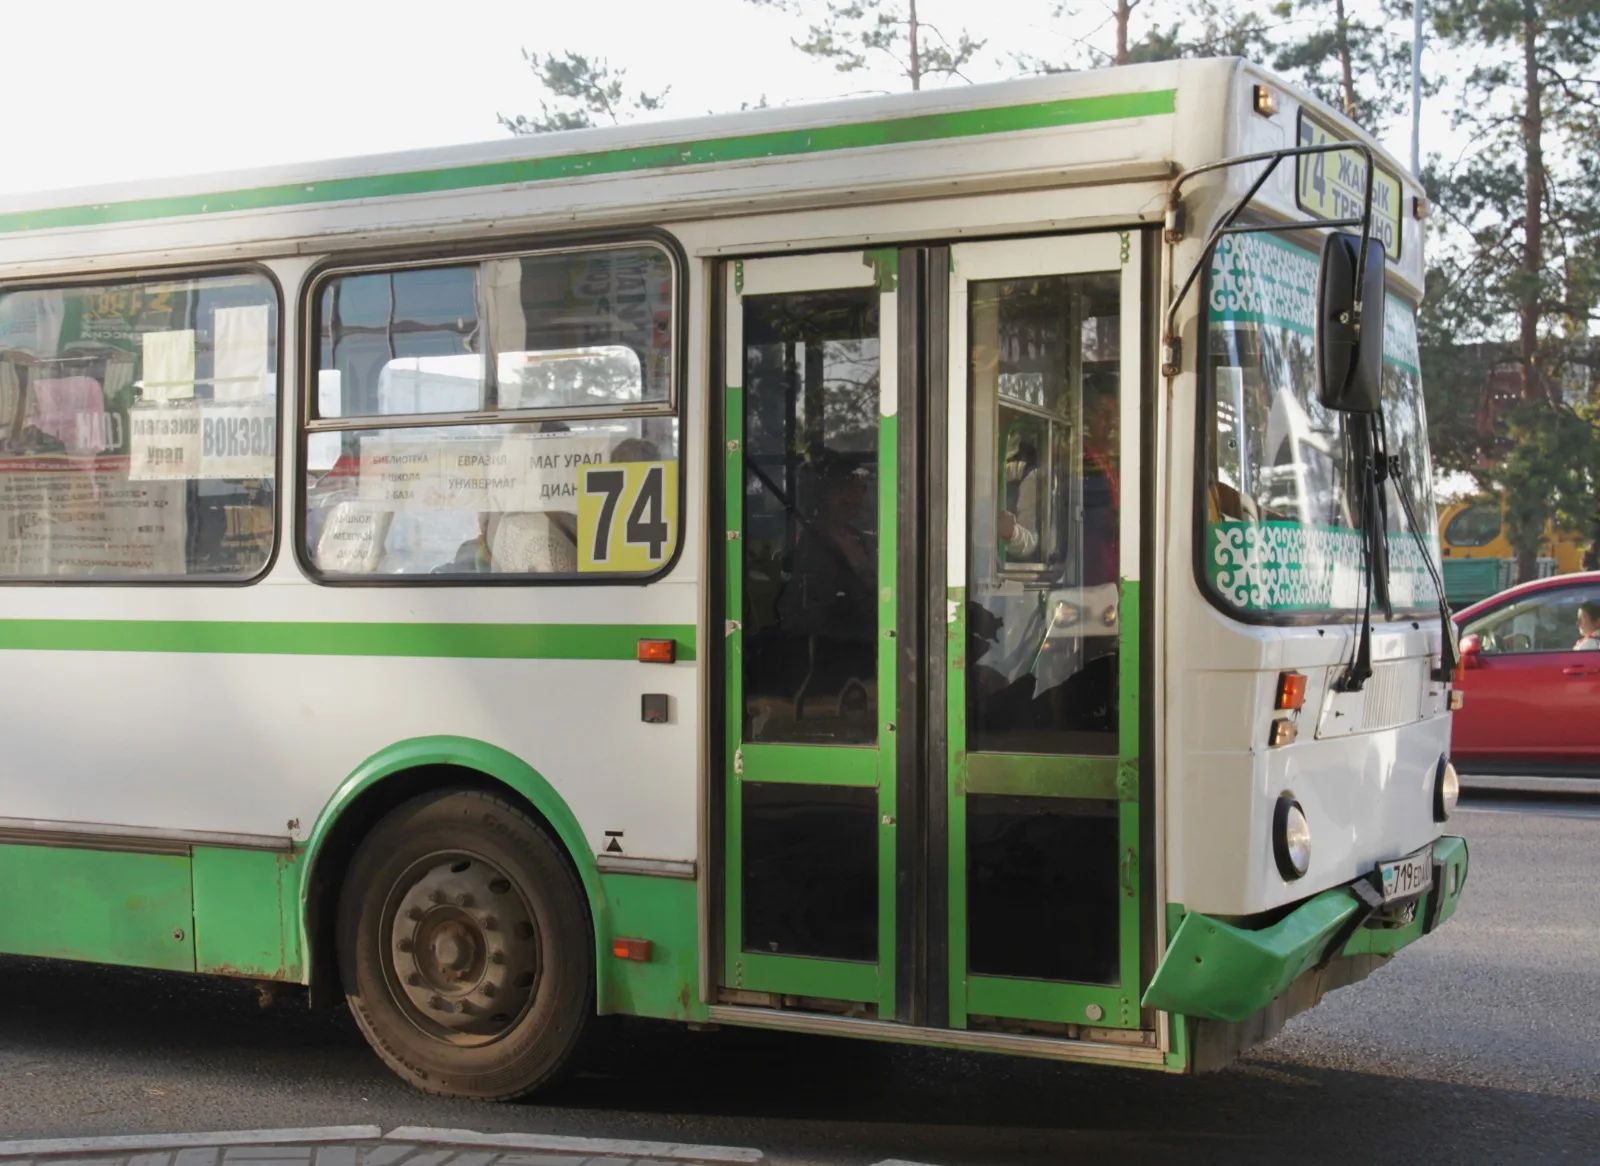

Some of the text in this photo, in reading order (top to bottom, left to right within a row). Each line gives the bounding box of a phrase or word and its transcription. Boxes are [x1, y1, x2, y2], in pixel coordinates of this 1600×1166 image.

[1301, 119, 1325, 208] 74
[372, 454, 430, 466] БИБЛИОТЕКА
[457, 455, 508, 467] ЕВРАЗИЯ
[530, 452, 603, 469] МАГ УРАЛ
[448, 477, 517, 490] УНИВЕРМАГ
[586, 467, 668, 561] 74
